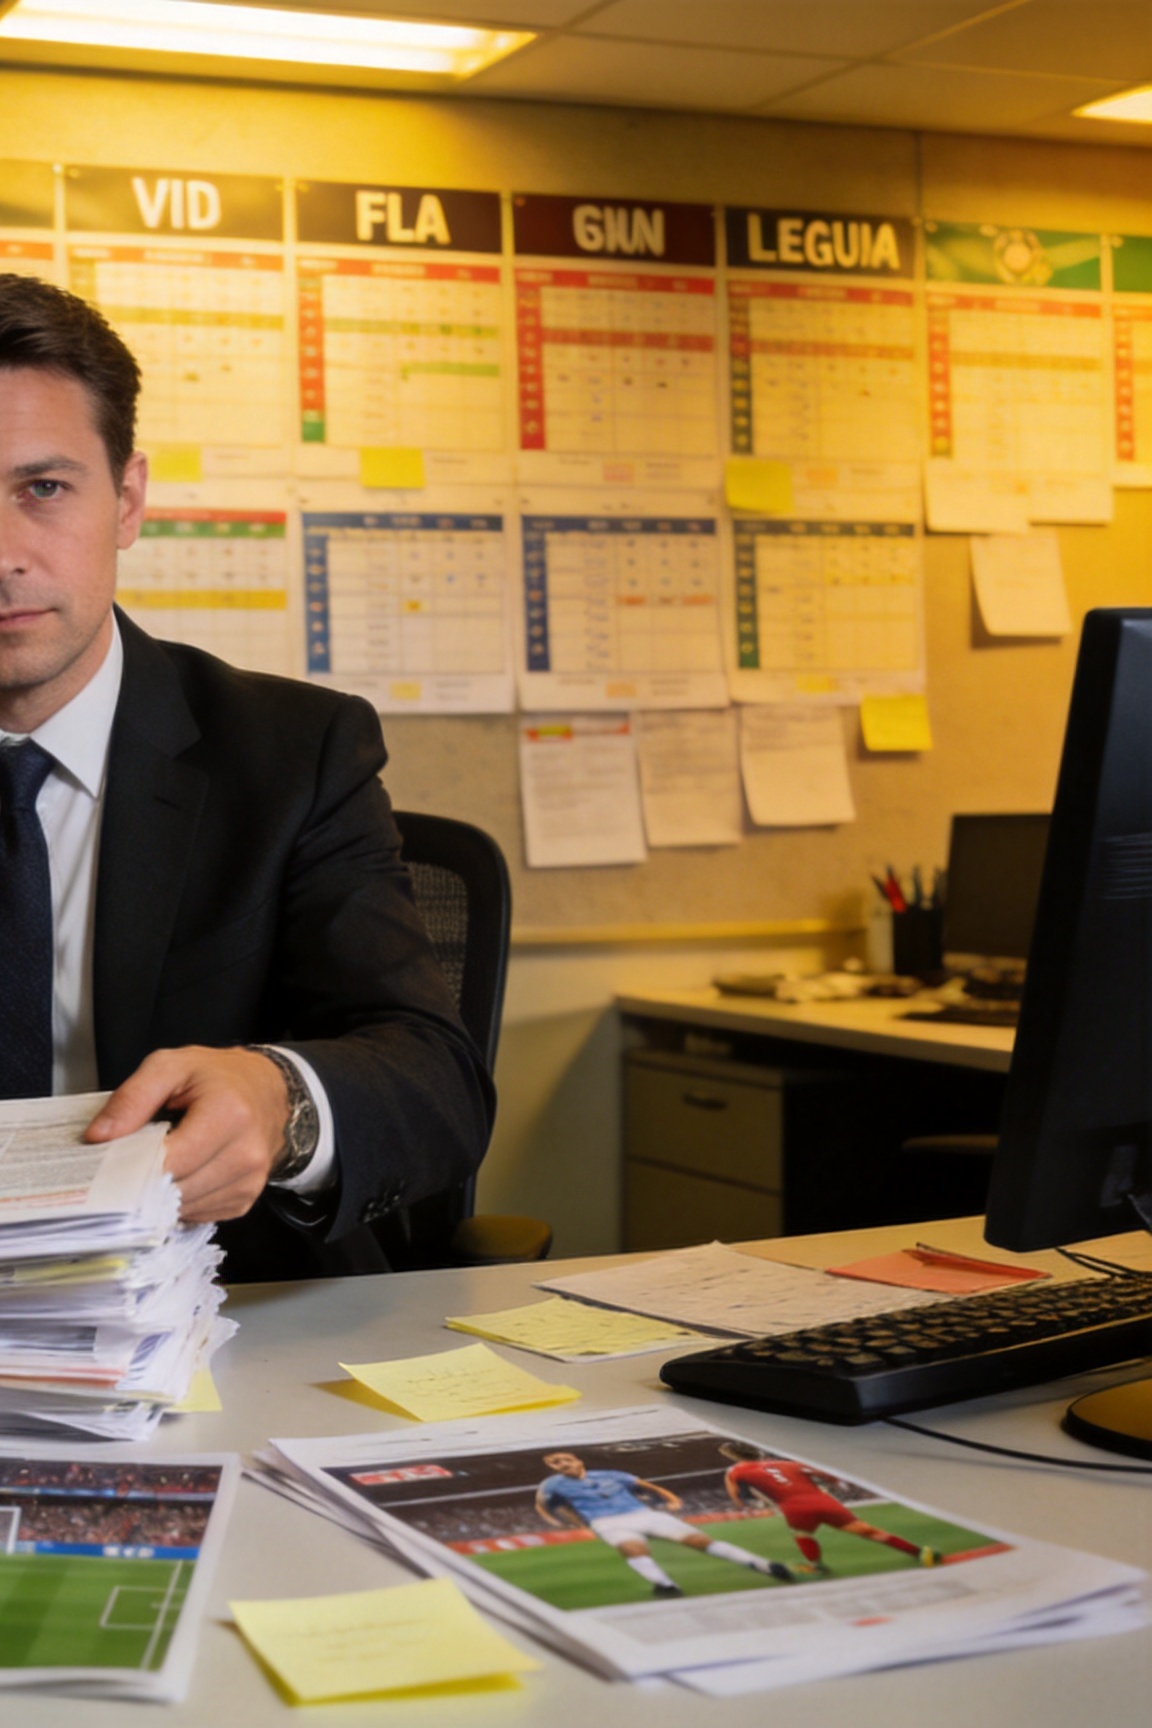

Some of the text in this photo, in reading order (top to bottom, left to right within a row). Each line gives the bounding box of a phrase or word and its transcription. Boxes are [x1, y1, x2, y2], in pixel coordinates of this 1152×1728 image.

[132, 176, 221, 229] VID
[356, 190, 451, 245] FLA
[748, 213, 900, 269] LEGUIA
